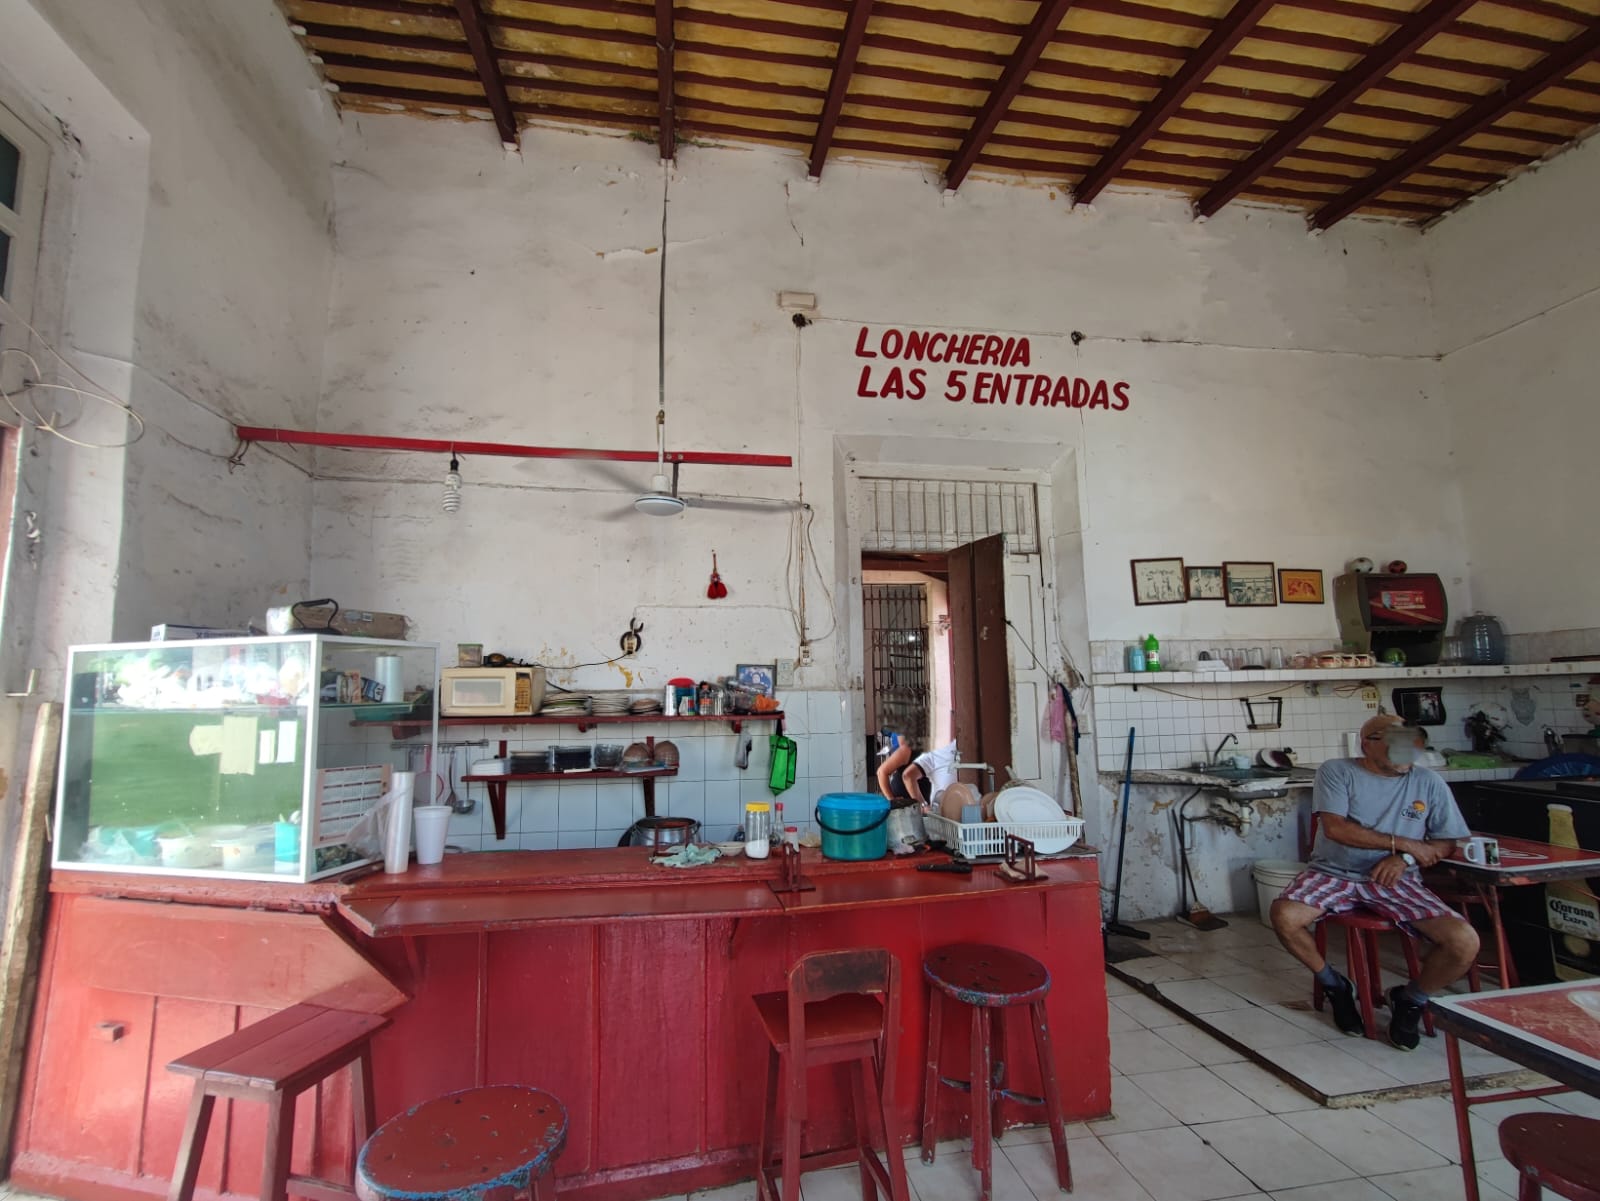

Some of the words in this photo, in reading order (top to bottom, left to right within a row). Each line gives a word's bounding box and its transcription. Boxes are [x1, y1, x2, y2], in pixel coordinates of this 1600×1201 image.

[855, 326, 1031, 367] LONCHERIA
[857, 365, 927, 401] LAS
[944, 370, 968, 402] 5
[972, 372, 1131, 411] ENTRADAS
[1550, 899, 1594, 919] Corona
[1562, 912, 1588, 926] Extra
